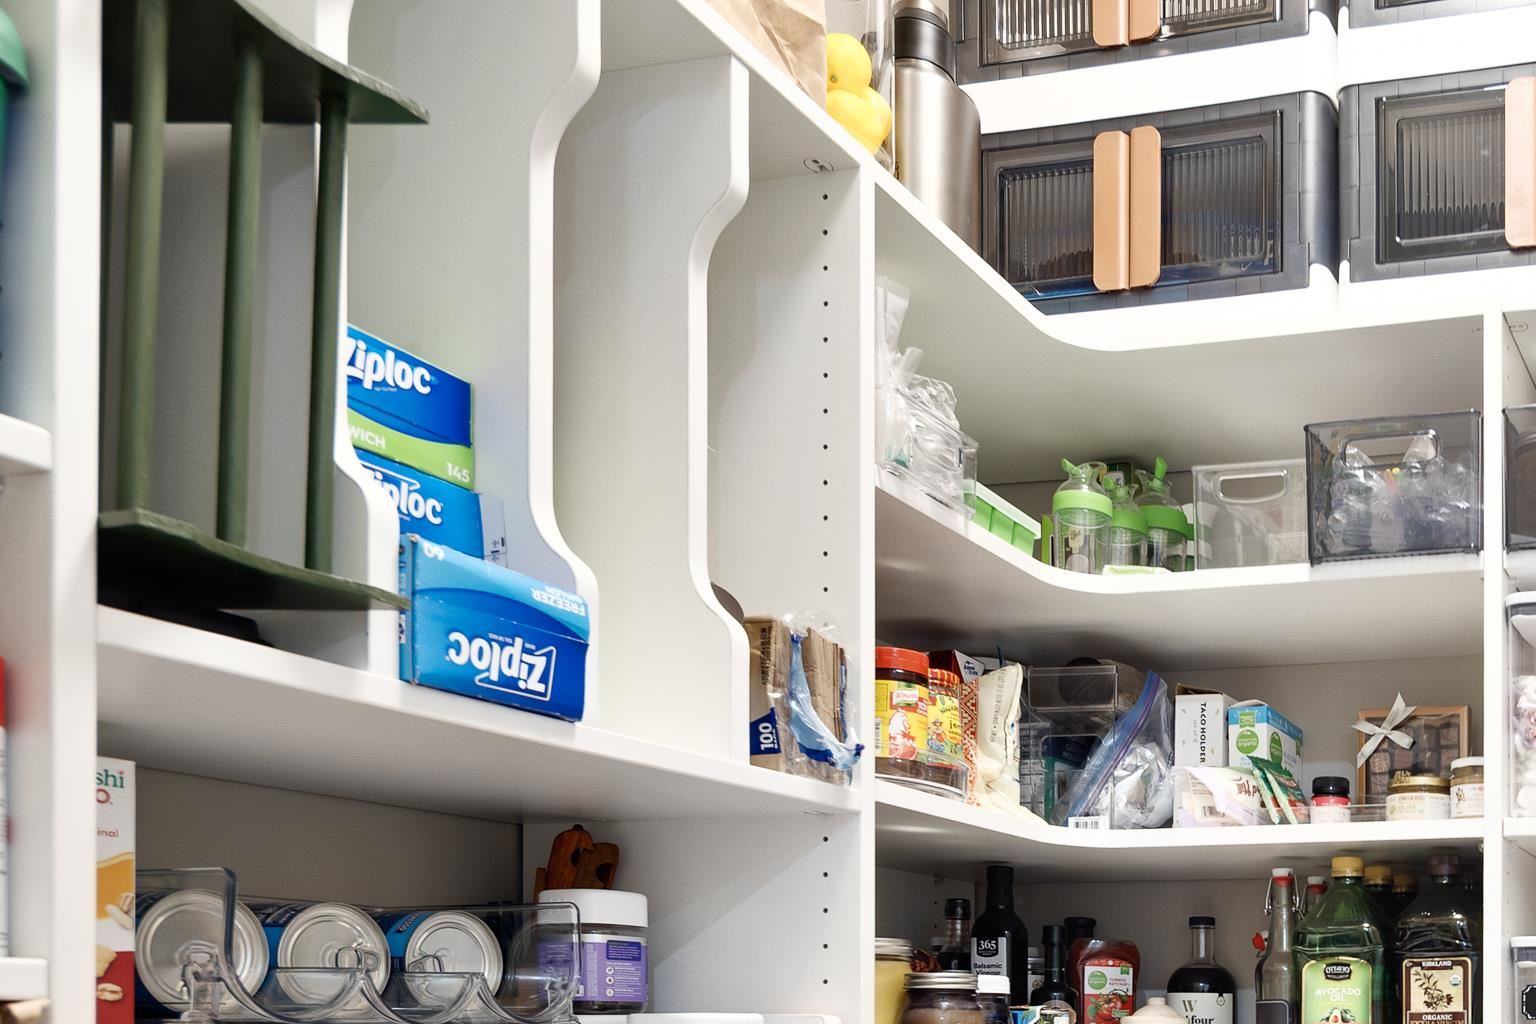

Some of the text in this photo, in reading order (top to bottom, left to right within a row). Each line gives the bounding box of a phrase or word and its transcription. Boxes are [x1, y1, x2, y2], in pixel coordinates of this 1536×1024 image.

[446, 462, 471, 483] 145
[448, 632, 547, 693] Ziploc
[759, 722, 774, 751] 100
[1199, 702, 1207, 763] TACO HOLDER
[978, 940, 997, 951] 365
[1315, 988, 1361, 996] AVOCADO
